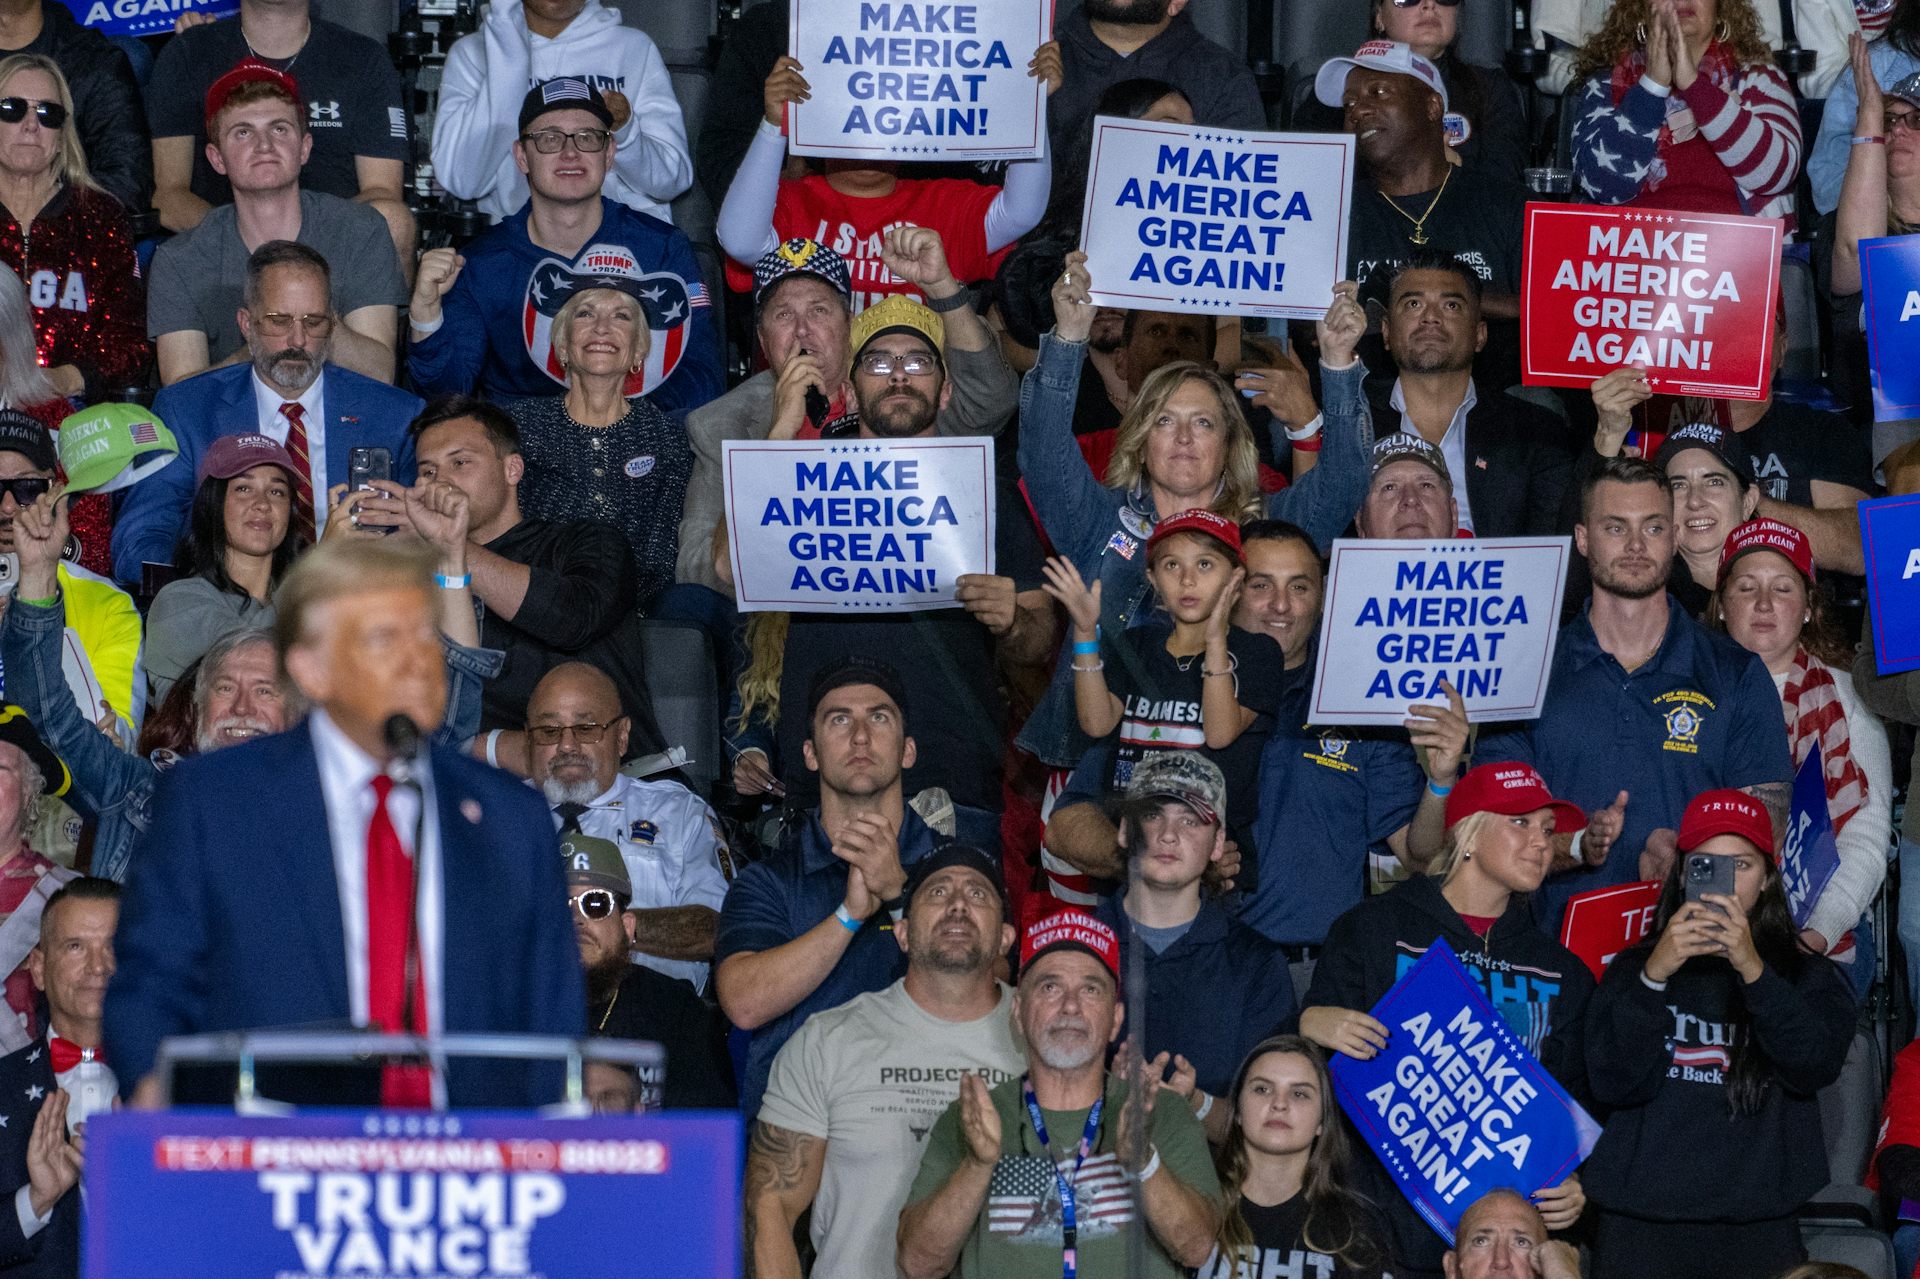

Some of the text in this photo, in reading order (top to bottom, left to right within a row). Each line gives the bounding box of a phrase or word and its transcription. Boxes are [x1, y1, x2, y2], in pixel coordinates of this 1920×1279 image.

[859, 2, 979, 34] MAKE
[822, 34, 1013, 70] AMERICA
[846, 70, 988, 103] GREAT
[841, 105, 989, 137] AGAIN!
[1156, 143, 1280, 184] MAKE
[1115, 177, 1313, 222] AMERICA
[1137, 216, 1286, 257] GREAT
[1588, 225, 1709, 263] MAKE
[587, 255, 632, 270] TRUMP
[1129, 252, 1286, 293] AGAIN!
[1551, 260, 1741, 302] AMERICA
[1573, 297, 1714, 335] GREAT
[1567, 332, 1713, 371] AGAIN!
[237, 436, 276, 447] TRUMP
[1373, 434, 1434, 455] TRUMP
[795, 459, 919, 492] MAKE
[760, 495, 959, 528] AMERICA
[787, 531, 933, 564] GREAT
[1732, 521, 1801, 542] MAKE AMERICA
[1737, 534, 1796, 552] GREAT AGAIN
[790, 565, 939, 594] AGAIN!
[1394, 559, 1505, 593] MAKE
[1355, 594, 1529, 629] AMERICA
[1375, 631, 1506, 665] GREAT
[1365, 667, 1504, 702] AGAIN!
[1495, 769, 1525, 781] MAKE
[1503, 777, 1537, 789] GREAT
[1702, 802, 1758, 818] TRUMP
[1027, 912, 1115, 942] MAKE AMERICA
[1032, 928, 1109, 955] GREAT AGAIN
[1447, 1004, 1538, 1116] MAKE
[1682, 1066, 1724, 1085] Back
[1401, 1011, 1532, 1171] AMERICA
[1396, 1055, 1495, 1172] GREAT
[166, 1139, 248, 1169] TEXT
[252, 1139, 502, 1170] PENNSYLVANIA
[509, 1140, 559, 1171] TO
[1366, 1081, 1471, 1205] AGAIN!
[258, 1172, 566, 1230] TRUMP
[292, 1224, 531, 1275] VANCE
